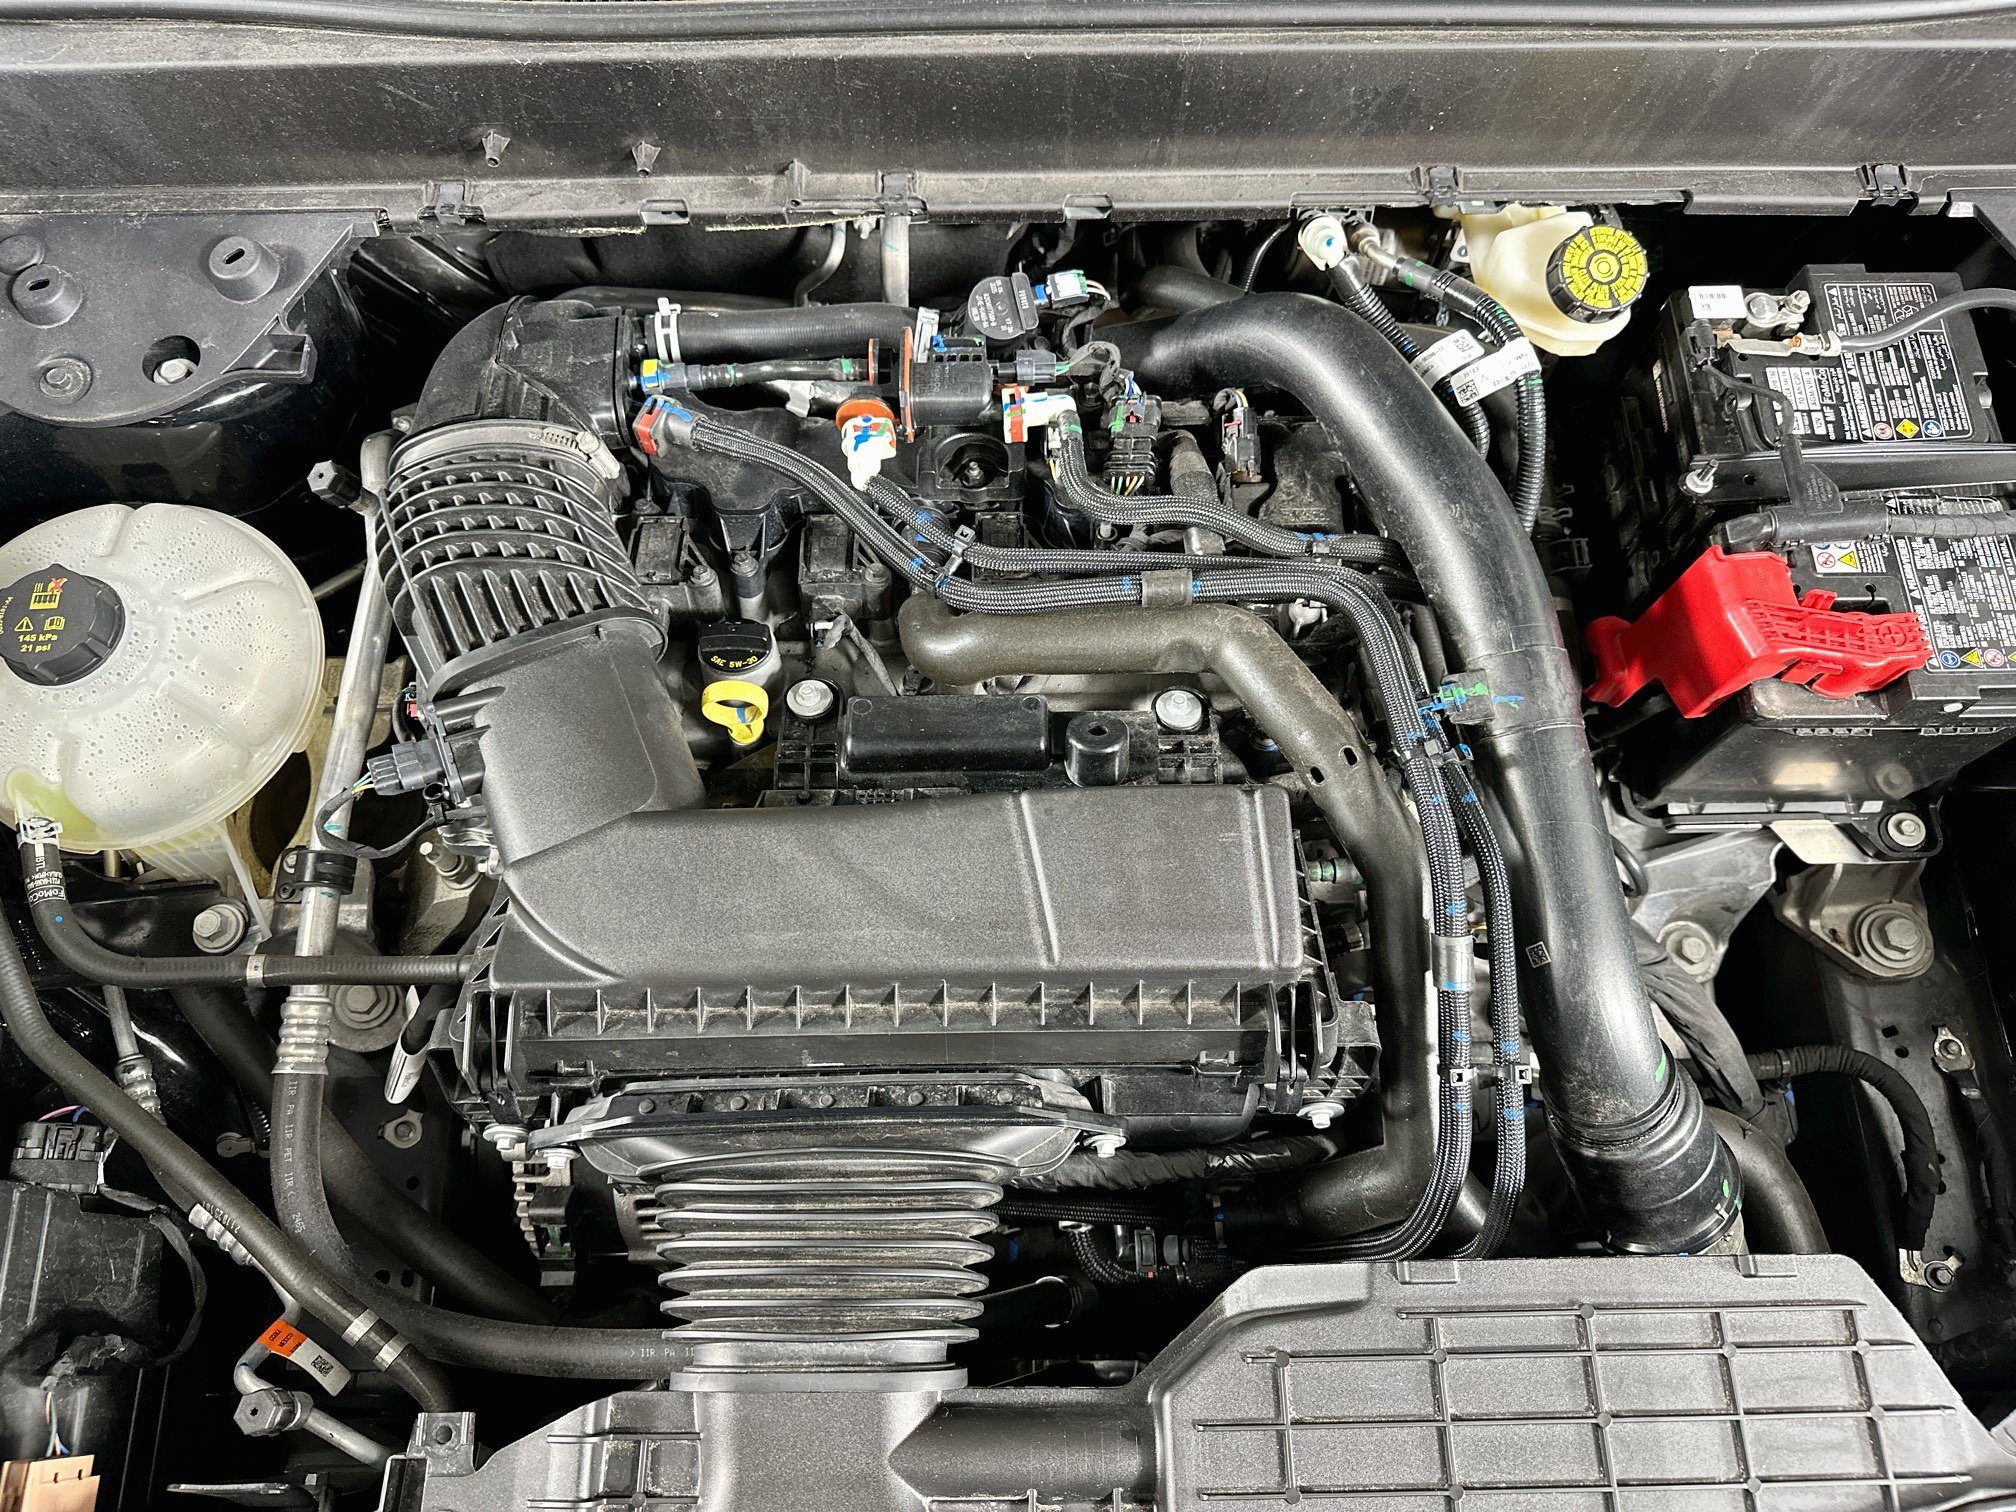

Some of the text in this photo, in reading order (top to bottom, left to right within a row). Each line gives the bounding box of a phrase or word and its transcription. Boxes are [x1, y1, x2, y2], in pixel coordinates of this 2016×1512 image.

[1816, 369, 1832, 402] FoMoCo
[1824, 406, 1836, 421] MF
[1999, 541, 2011, 558] ABRA.
[1896, 539, 1917, 590] PELIGRO/VENENO
[2004, 559, 2013, 567] LA
[2007, 567, 2016, 575] NO
[18, 633, 58, 642] 145 kPa
[20, 643, 52, 653] 21 psi
[710, 655, 759, 668] SAE 5W-30
[35, 857, 45, 872] BTL
[28, 889, 64, 903] FoMoCo
[284, 1148, 293, 1162] PET
[664, 1348, 676, 1357] PA
